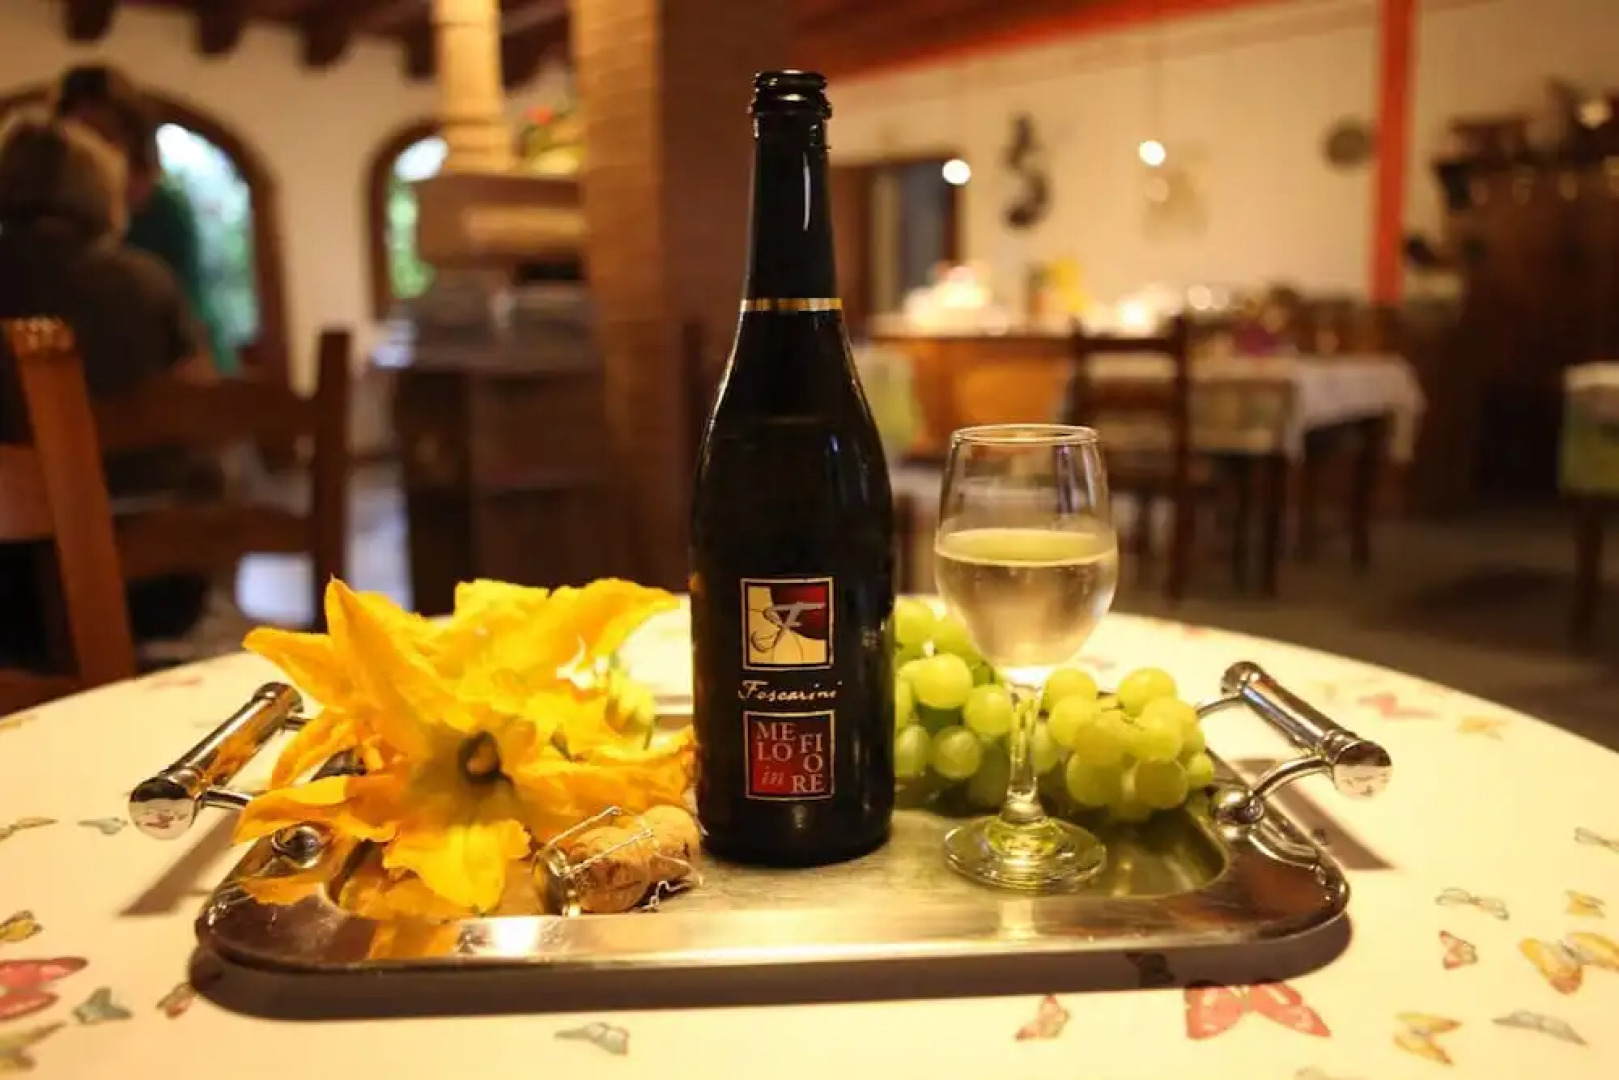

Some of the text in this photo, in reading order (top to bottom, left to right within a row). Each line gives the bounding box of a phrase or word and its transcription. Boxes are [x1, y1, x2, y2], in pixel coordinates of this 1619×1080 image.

[757, 721, 797, 741] ME
[757, 741, 793, 762] LO
[800, 733, 823, 754] FI
[803, 753, 823, 773] O
[762, 765, 784, 786] in
[791, 773, 824, 793] RE
